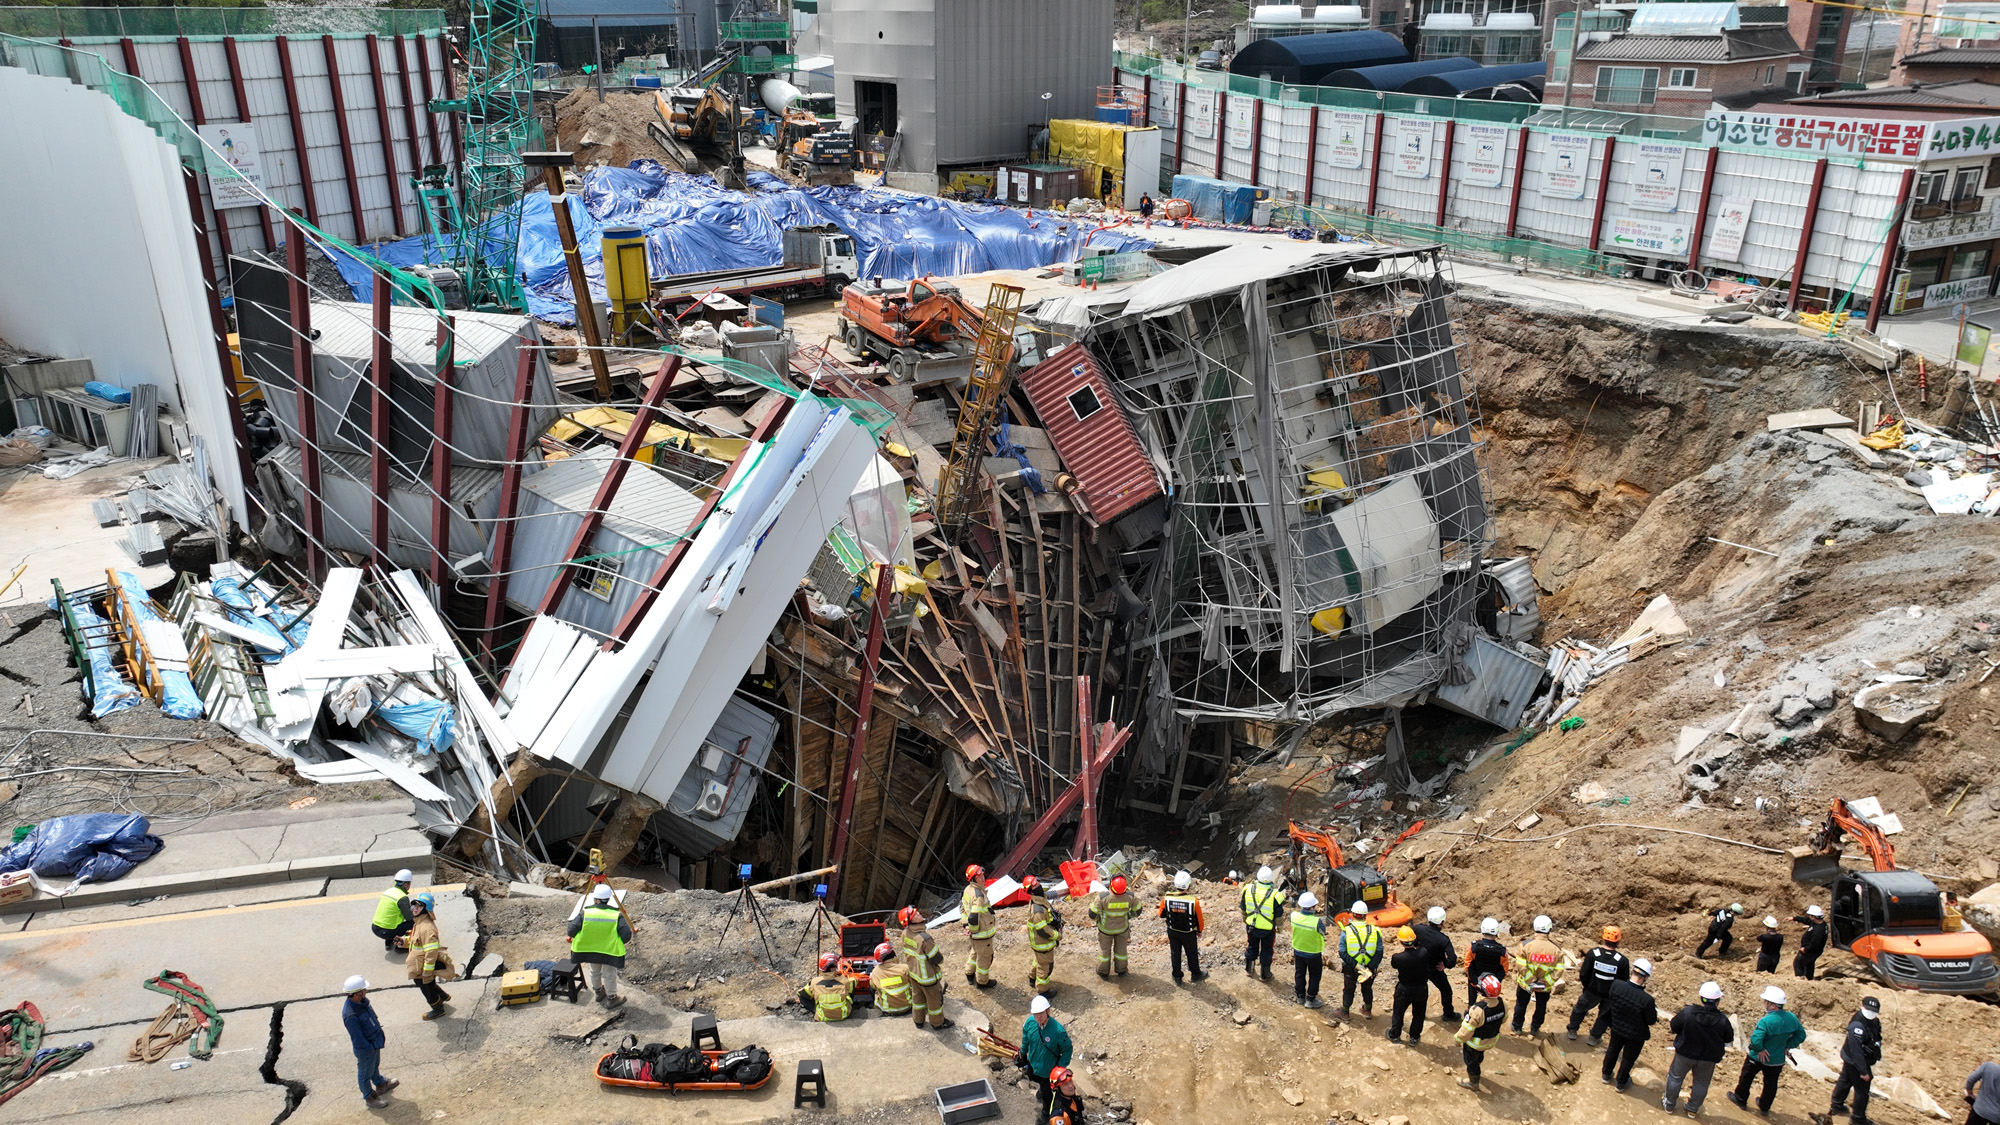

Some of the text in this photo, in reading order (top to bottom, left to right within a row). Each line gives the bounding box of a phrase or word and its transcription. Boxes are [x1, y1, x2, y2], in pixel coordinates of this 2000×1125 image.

[1775, 118, 1926, 157] 생선구이전문점
[1636, 238, 1663, 249] 안전통로
[959, 319, 980, 338] DOOSAN
